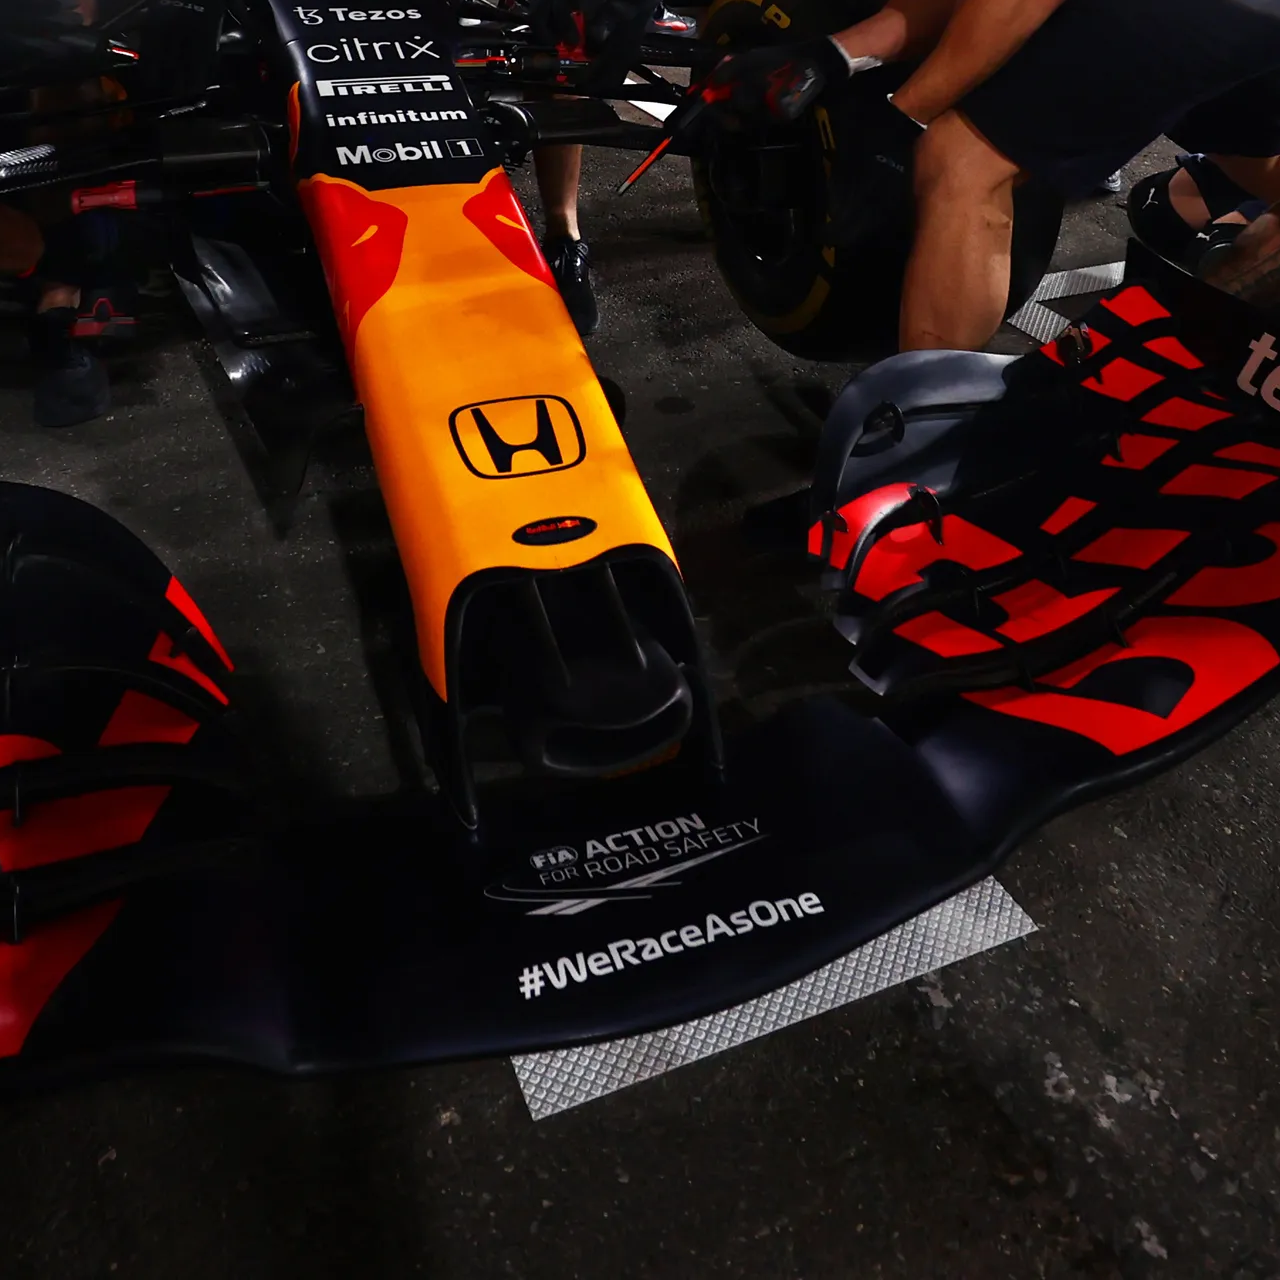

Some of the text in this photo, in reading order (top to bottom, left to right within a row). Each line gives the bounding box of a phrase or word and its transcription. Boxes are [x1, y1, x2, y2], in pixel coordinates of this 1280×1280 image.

[329, 7, 422, 22] Tezos
[306, 35, 440, 63] citrix
[315, 74, 454, 97] PIRELLI
[326, 108, 468, 128] infinitum
[336, 140, 443, 166] Mobil
[584, 812, 707, 860] ACTION
[538, 817, 761, 886] FOR ROAD SAFETY
[517, 891, 826, 1001] #WeRaceAsOne
